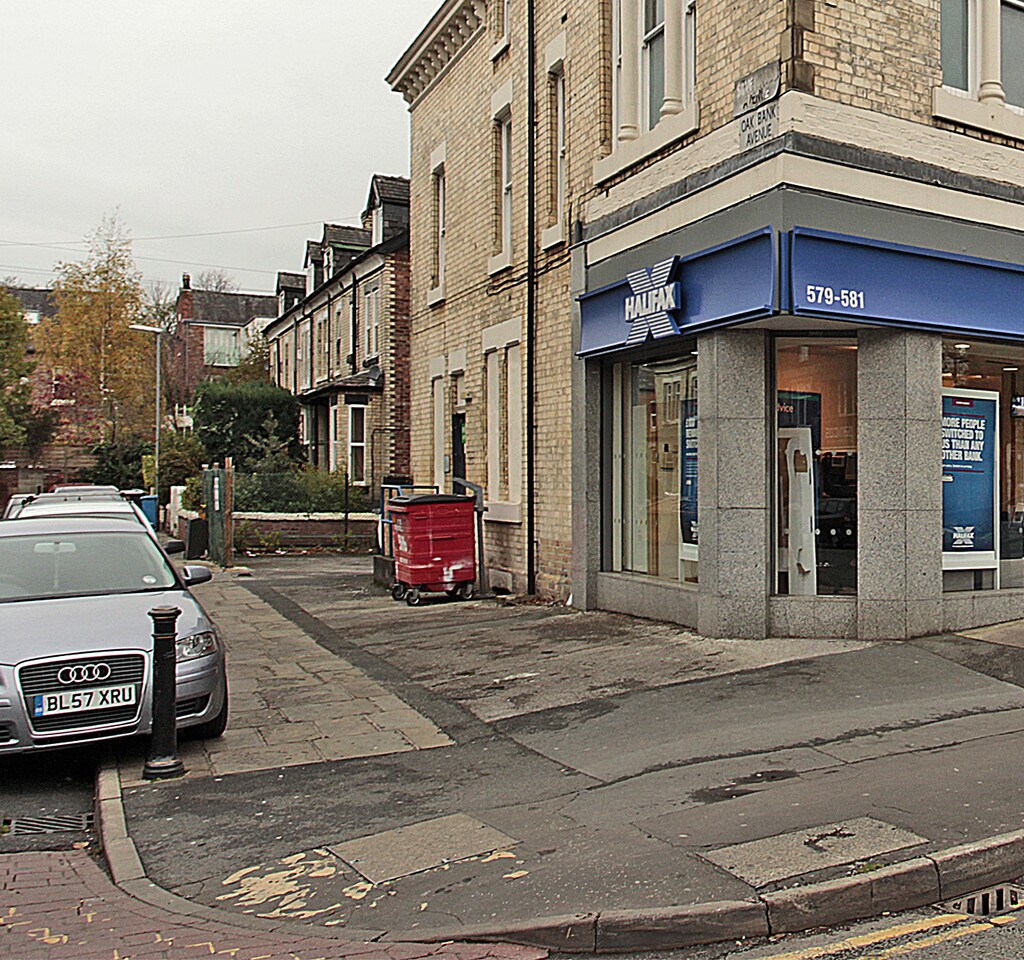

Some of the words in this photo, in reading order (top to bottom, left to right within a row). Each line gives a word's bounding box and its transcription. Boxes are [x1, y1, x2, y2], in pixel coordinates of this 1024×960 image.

[741, 115, 755, 133] OAK
[757, 104, 777, 125] BANK
[746, 124, 773, 147] AVENUE
[625, 283, 675, 321] HALIFAX
[806, 285, 865, 309] 579-581
[942, 428, 974, 439] SWITCHED
[975, 430, 984, 440] TO
[961, 418, 986, 430] PEOPLE
[951, 439, 970, 450] THAN
[971, 440, 985, 451] ANY
[47, 692, 94, 711] BL57
[99, 687, 133, 705] XRU
